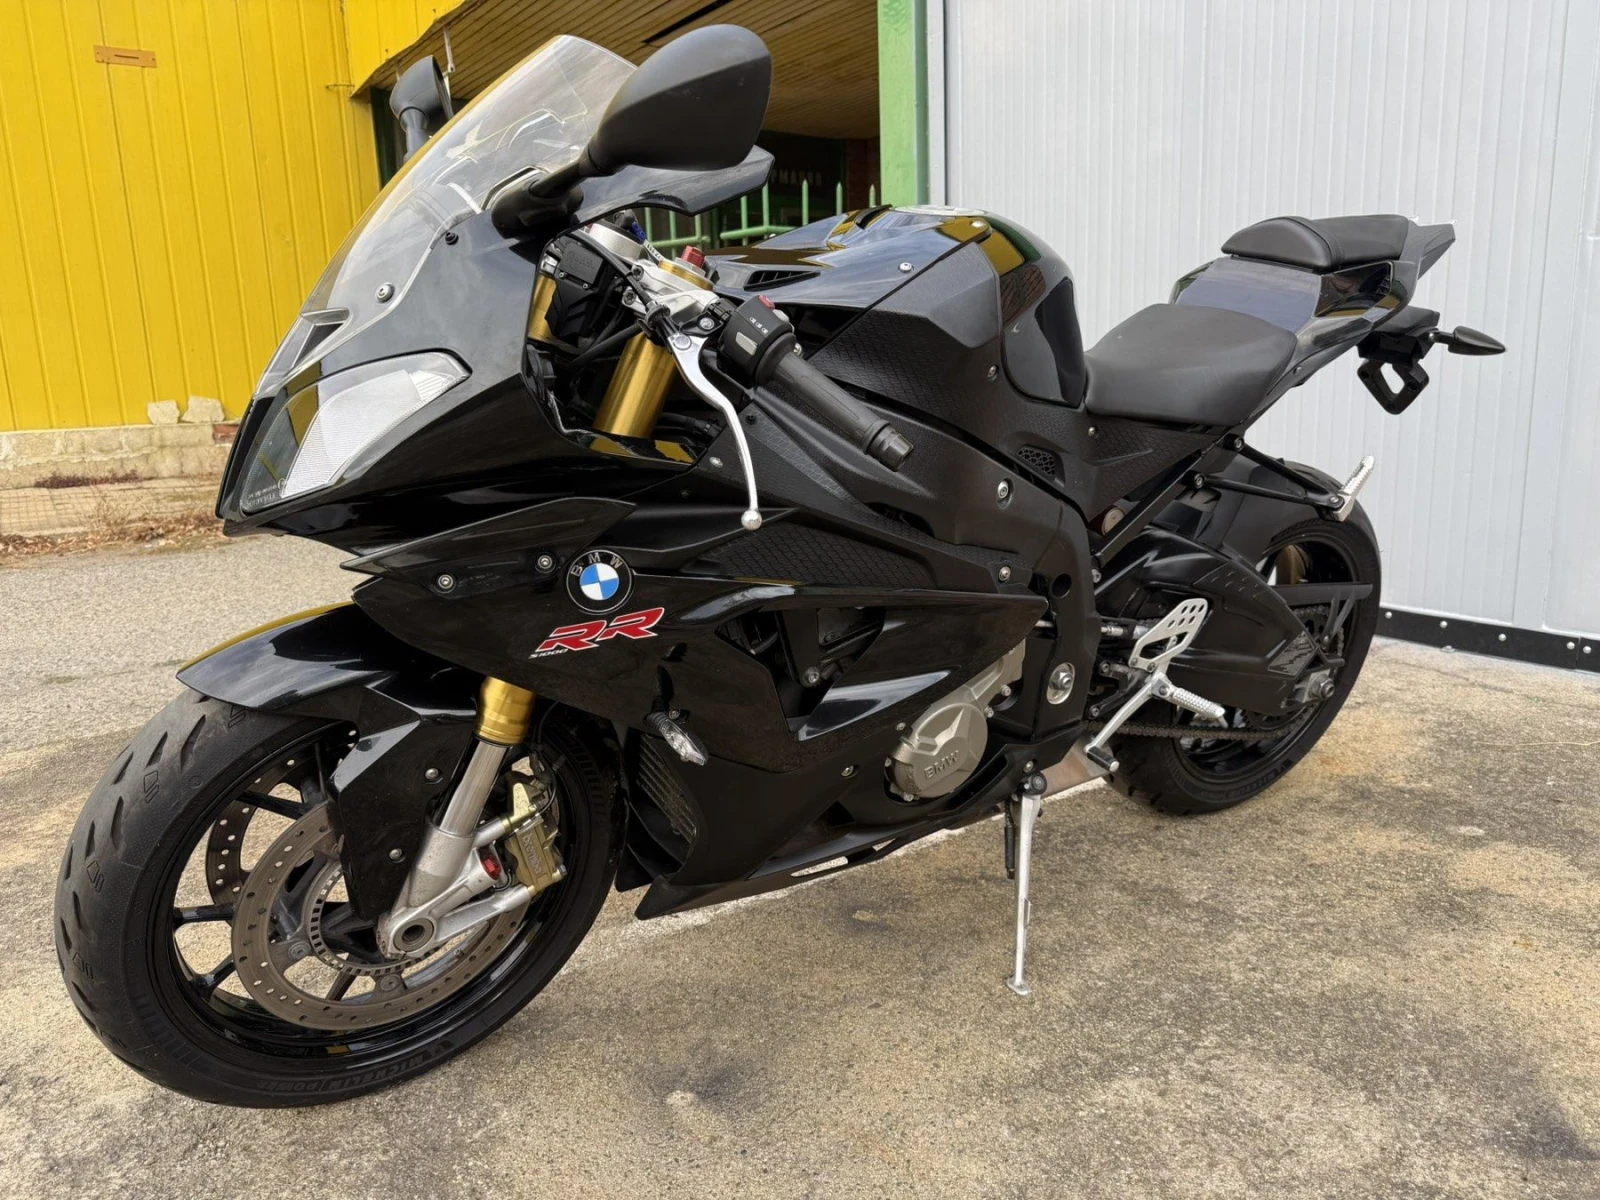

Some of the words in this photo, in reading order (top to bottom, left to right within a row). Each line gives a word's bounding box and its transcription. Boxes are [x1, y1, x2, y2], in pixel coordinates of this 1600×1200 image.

[571, 551, 624, 577] BMW
[535, 607, 665, 652] RR
[528, 649, 568, 659] S1000
[924, 750, 959, 780] BMW
[328, 1054, 425, 1090] MICHELIN
